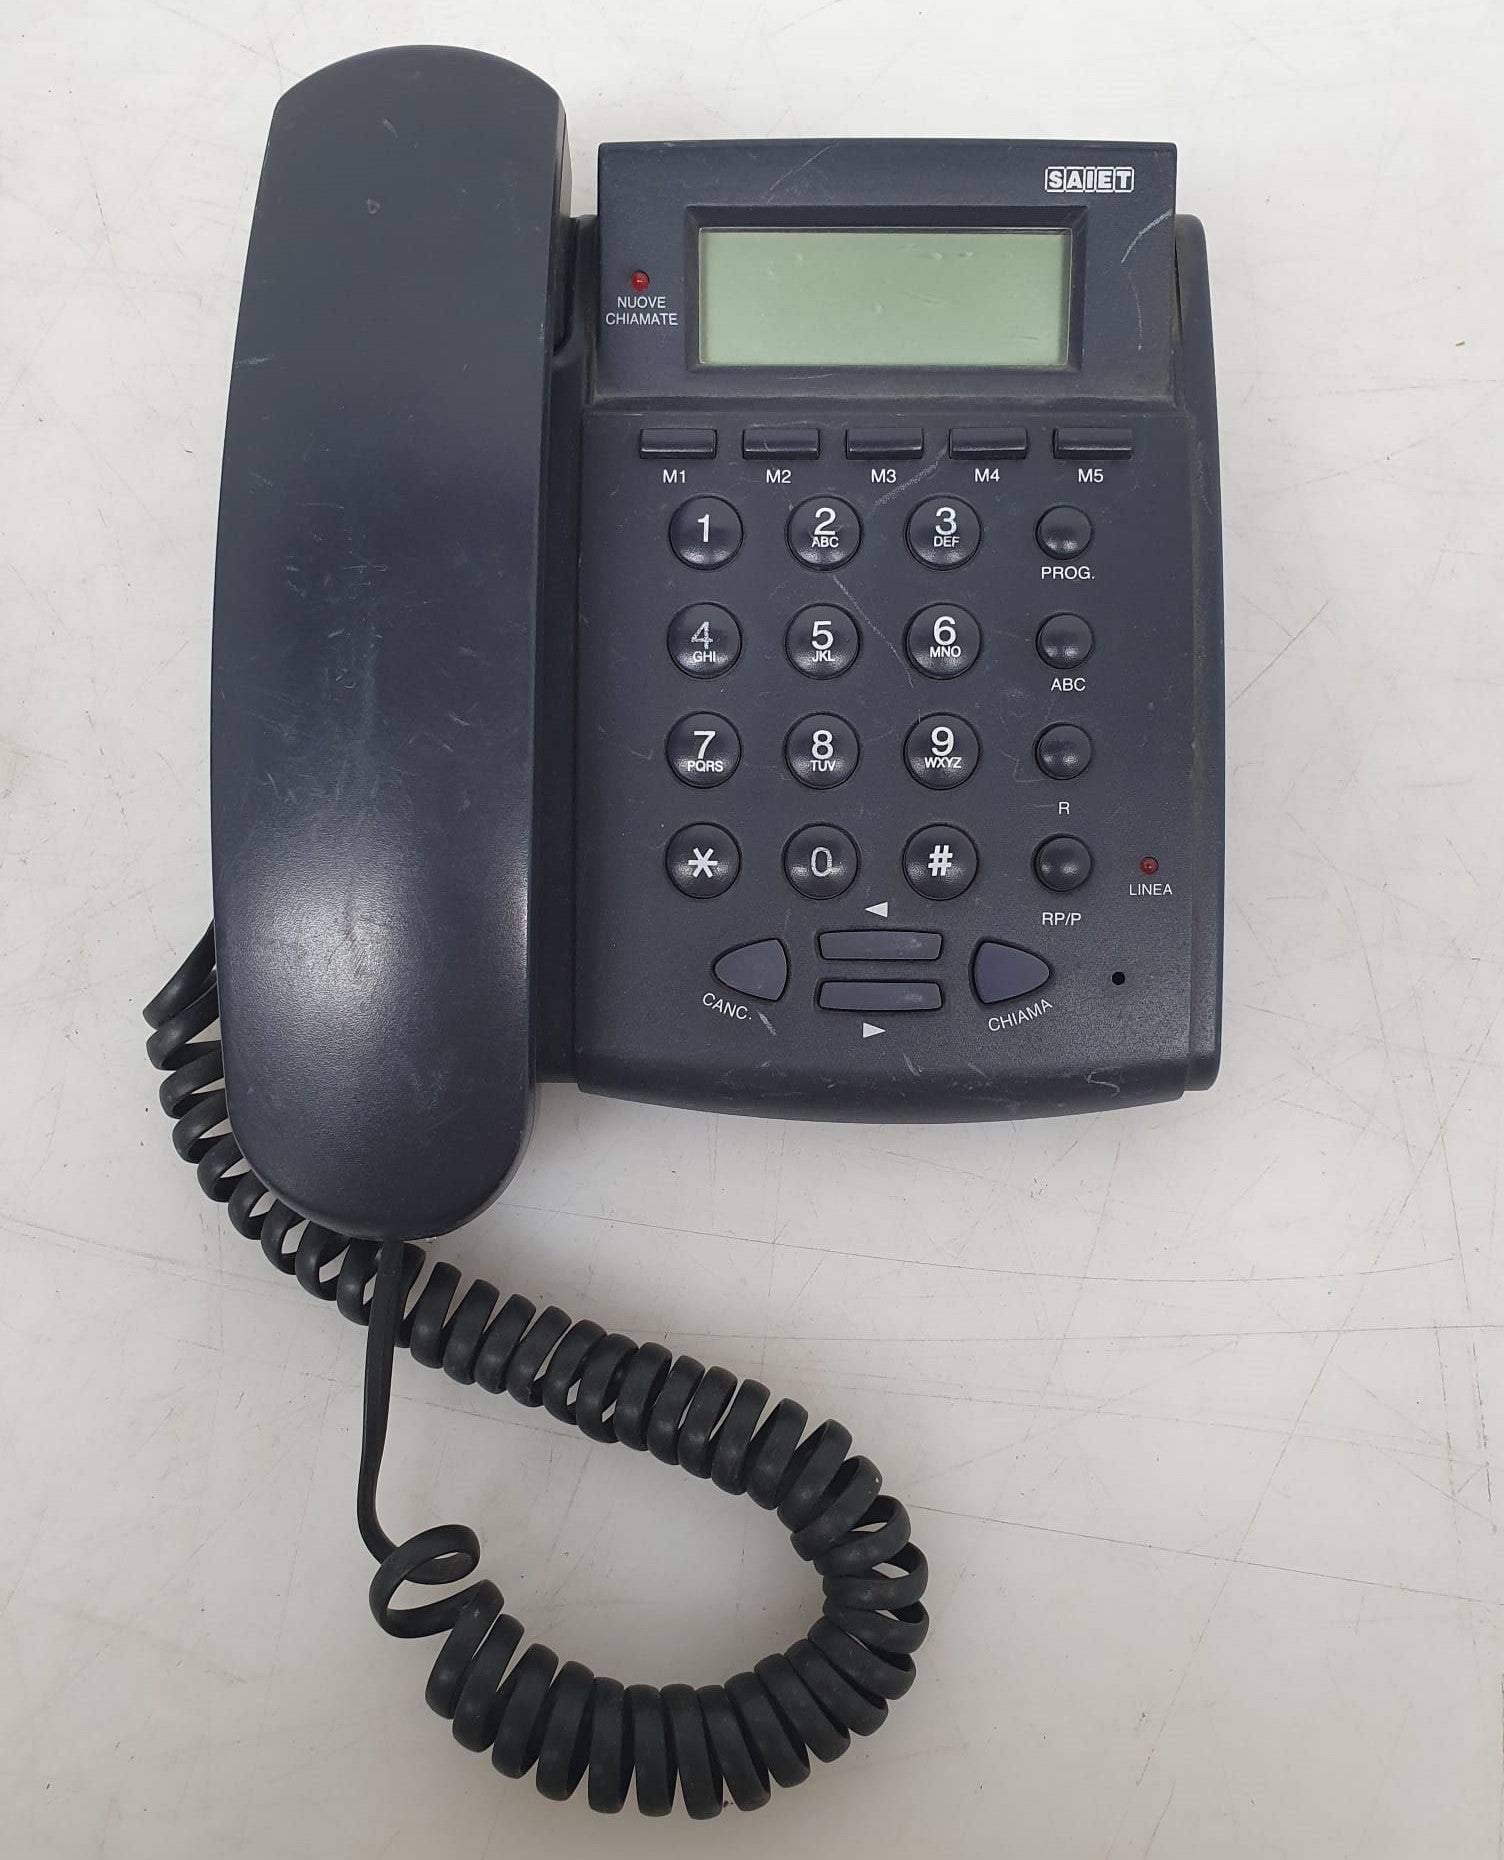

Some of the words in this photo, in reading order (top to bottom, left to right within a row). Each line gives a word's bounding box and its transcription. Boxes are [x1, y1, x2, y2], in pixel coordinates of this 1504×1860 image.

[1044, 166, 1135, 193] SAIET
[616, 296, 667, 309] NUOVE
[605, 311, 678, 326] CHIAMATE
[662, 469, 686, 484] M1
[765, 469, 792, 484] M2
[870, 469, 897, 484] M3
[973, 468, 1001, 484] M4
[1077, 468, 1104, 484] M5
[697, 514, 710, 543] 1
[813, 507, 837, 536] 2
[934, 507, 957, 536] 3
[811, 537, 839, 548] ABC
[933, 535, 960, 548] DEF
[1040, 566, 1095, 581] PROG.
[690, 621, 714, 650] 4
[811, 620, 834, 650] 5
[932, 616, 957, 646] 6
[692, 650, 716, 664] GHI
[812, 650, 835, 663] JKL
[929, 645, 962, 659] MNO
[1050, 677, 1086, 692] ABC
[693, 730, 716, 760] 7
[811, 729, 834, 760] 8
[930, 726, 955, 756] 9
[687, 759, 724, 774] PQRS
[810, 759, 836, 773] TUV
[924, 756, 962, 769] WXYZ
[1058, 801, 1070, 815] R
[810, 847, 833, 877] 0
[1128, 883, 1173, 896] LINEA
[1041, 911, 1082, 927] RP/P
[702, 992, 753, 1022] CANC.
[987, 998, 1054, 1032] CHIAMA
